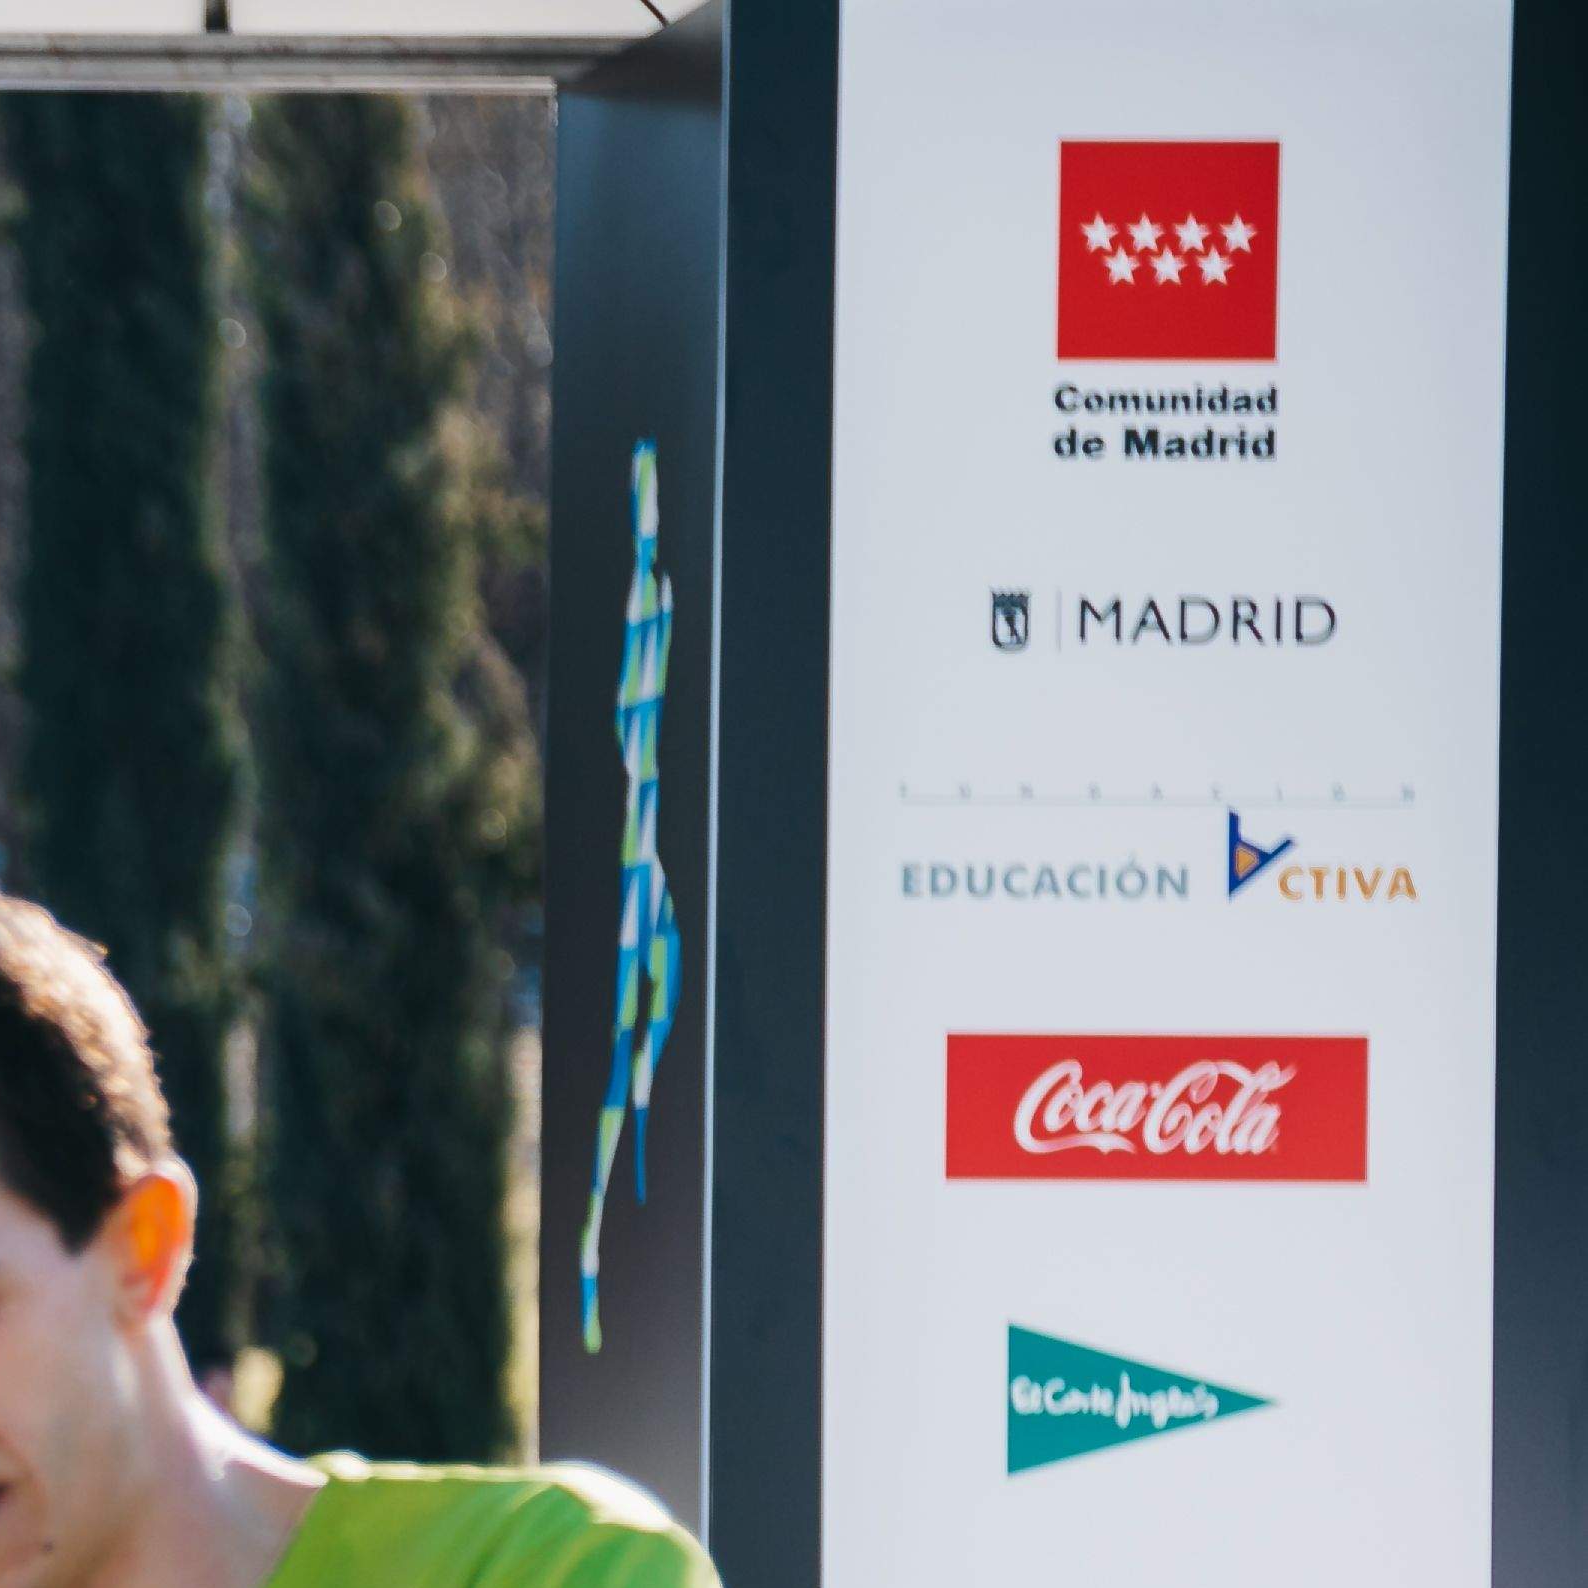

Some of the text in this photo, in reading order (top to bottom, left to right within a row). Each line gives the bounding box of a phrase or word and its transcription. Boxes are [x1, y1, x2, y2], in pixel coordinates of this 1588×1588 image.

[1054, 382, 1279, 416] Comunidad
[1053, 426, 1278, 460] de Madrid
[1078, 596, 1338, 646] MADRID
[900, 852, 1190, 900] EDUCACIÓN
[1013, 1059, 1297, 1155] Coca-Cola
